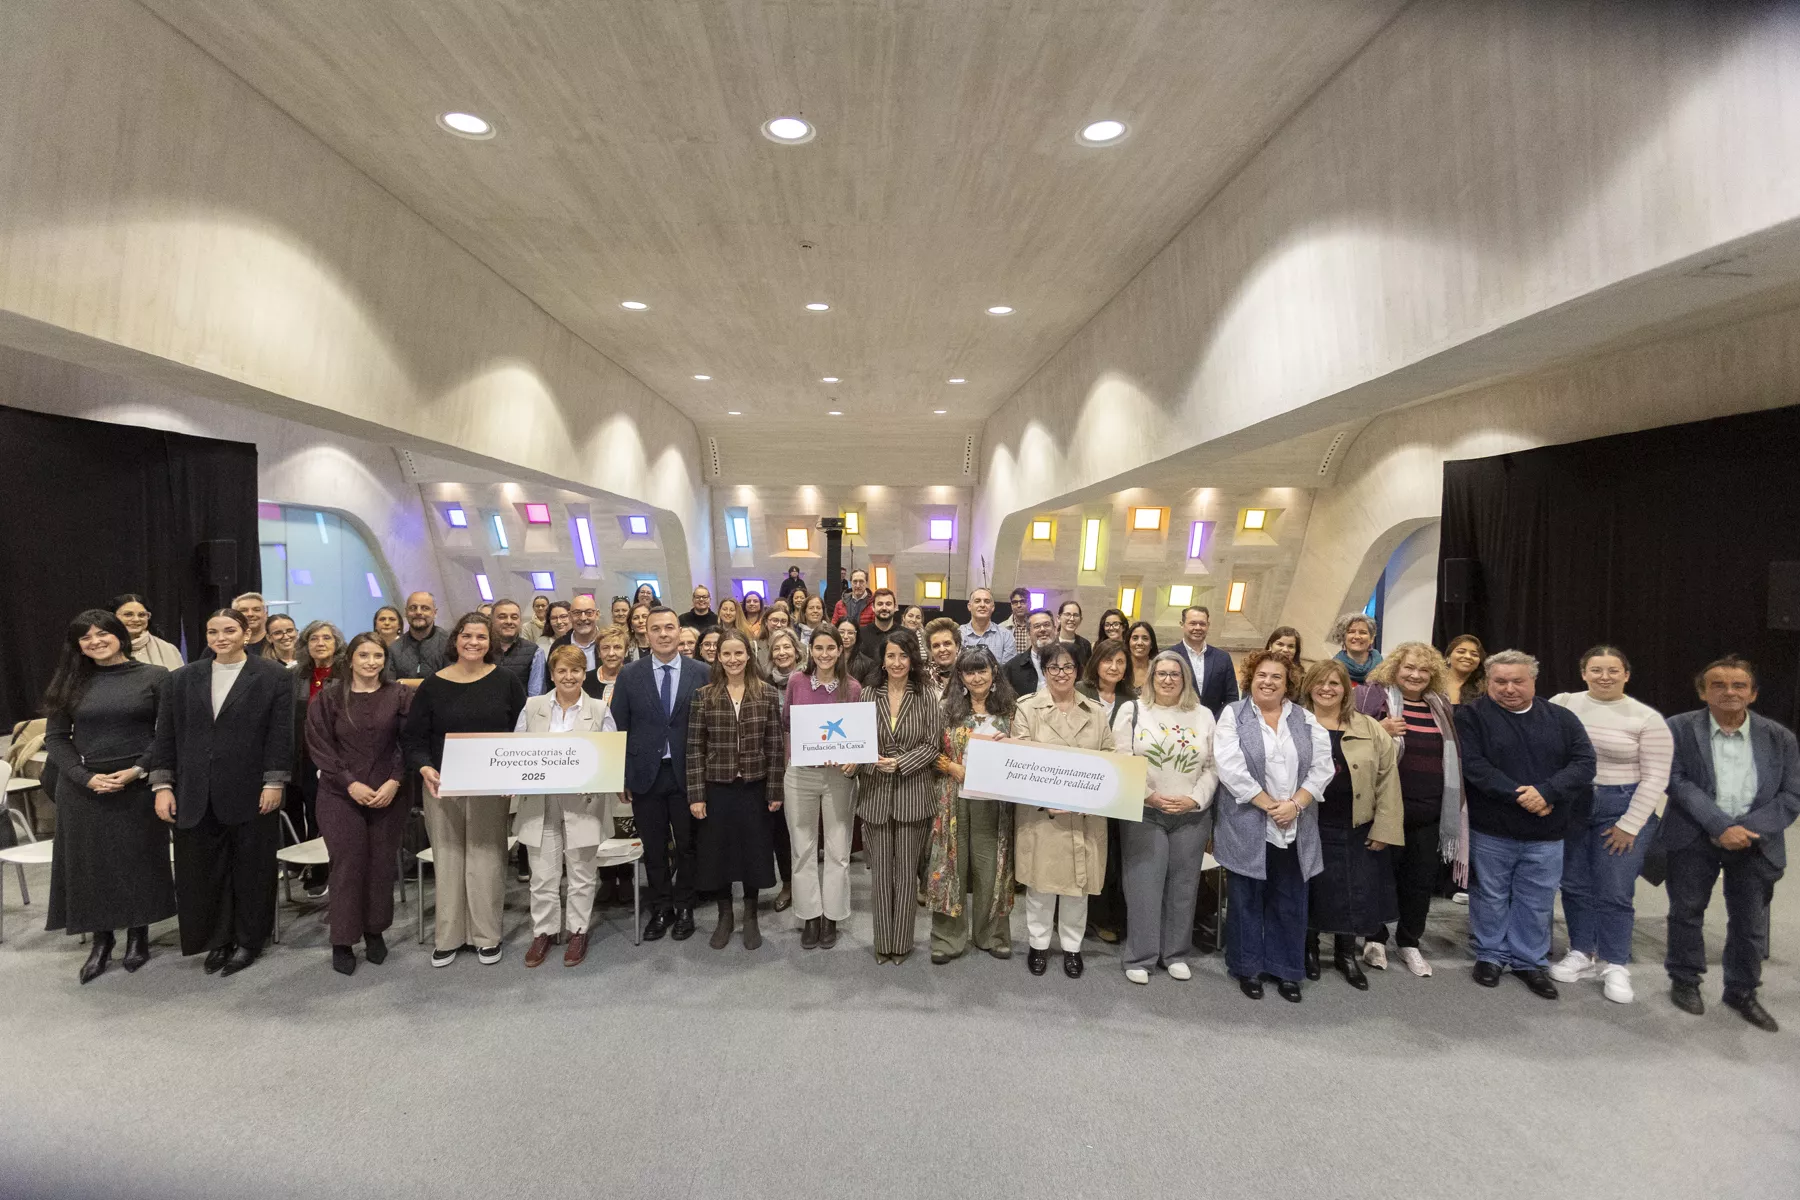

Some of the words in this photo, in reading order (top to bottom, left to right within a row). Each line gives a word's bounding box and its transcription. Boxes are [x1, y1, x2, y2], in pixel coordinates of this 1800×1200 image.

[494, 748, 563, 756] Convocatorias
[566, 747, 577, 756] de
[802, 743, 836, 751] Fundación
[489, 758, 538, 768] Proyectos
[541, 757, 580, 766] Sociales
[1004, 758, 1040, 771] Hacerlo
[1040, 765, 1106, 781] conjuntamente
[522, 773, 546, 781] 2025
[1006, 770, 1028, 781] para
[1029, 772, 1062, 786] hacerlo
[1064, 778, 1101, 792] realidad
